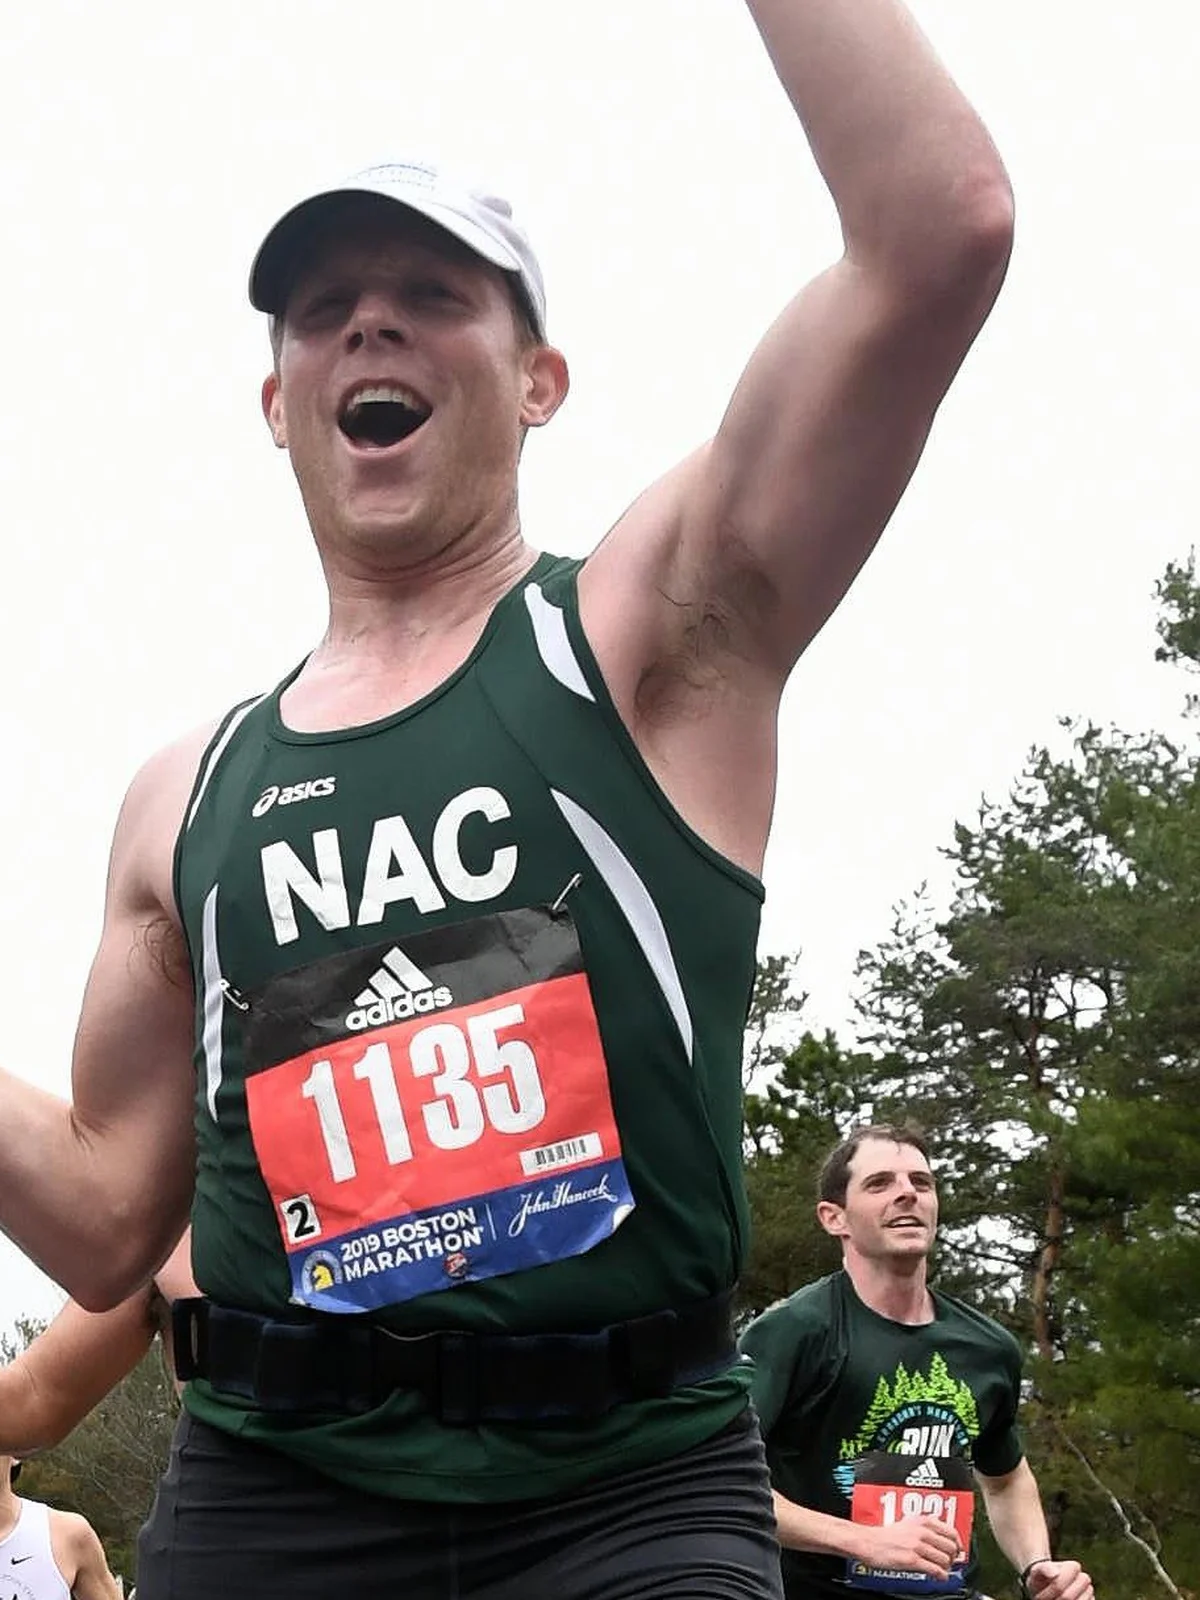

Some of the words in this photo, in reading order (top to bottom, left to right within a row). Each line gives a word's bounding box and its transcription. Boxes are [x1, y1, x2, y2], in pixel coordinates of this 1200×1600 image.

[278, 776, 336, 805] asics
[260, 786, 518, 946] NAC
[345, 986, 453, 1030] adidas
[301, 1004, 547, 1184] 1135
[285, 1199, 316, 1239] 2
[508, 1190, 551, 1237] John
[551, 1174, 619, 1209] Hancock
[341, 1234, 381, 1262] 2019
[382, 1205, 477, 1248] BOSTON
[343, 1227, 482, 1282] MARATHON
[900, 1423, 956, 1458] RUN
